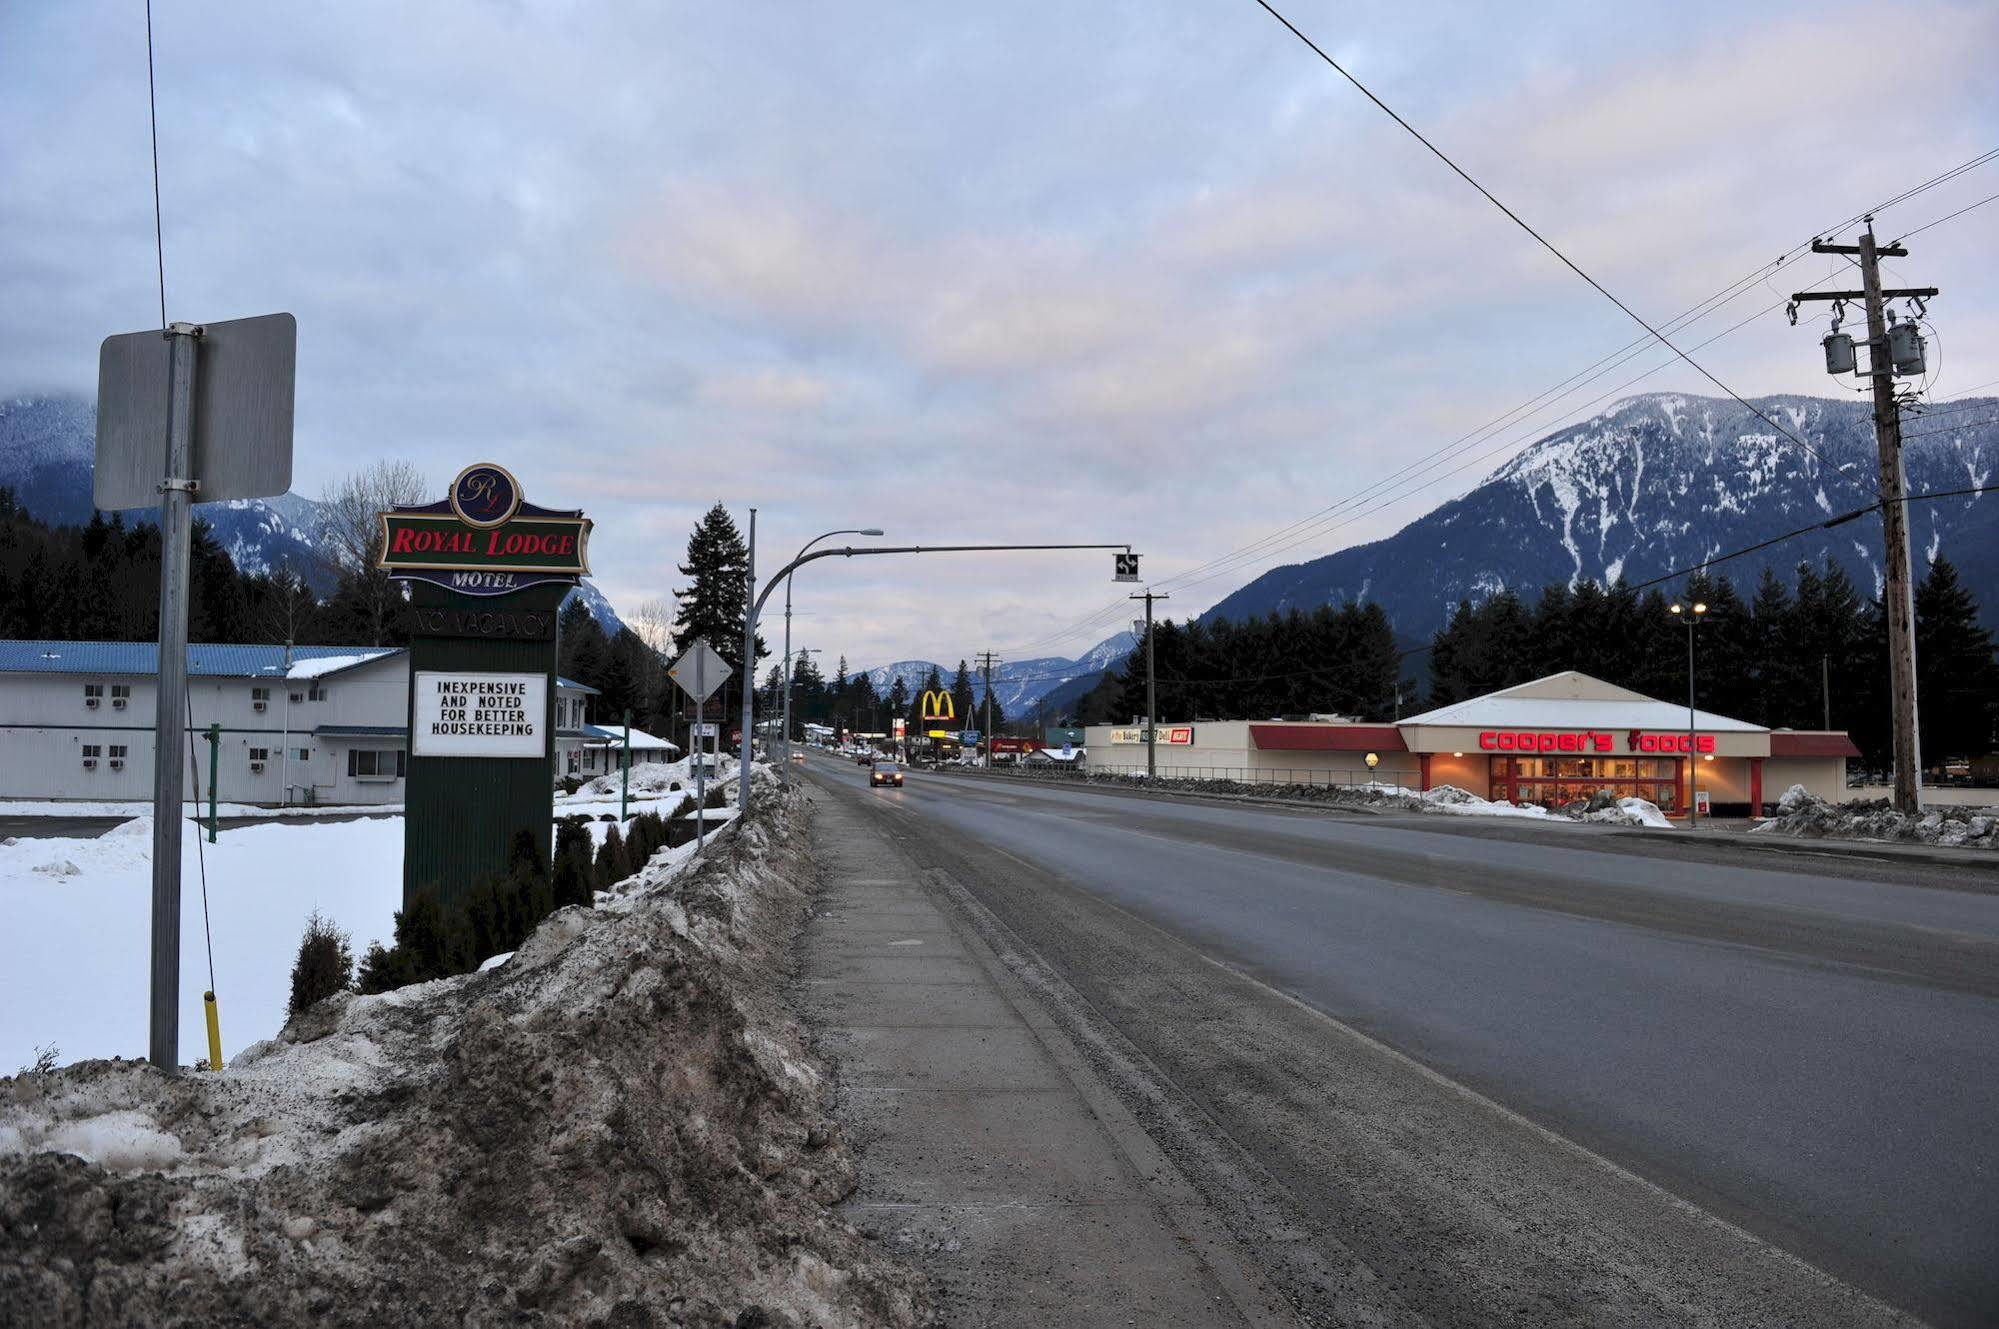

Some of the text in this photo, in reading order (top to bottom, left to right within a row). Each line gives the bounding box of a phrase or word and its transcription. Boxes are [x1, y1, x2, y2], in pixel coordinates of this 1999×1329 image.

[392, 527, 575, 556] ROYAL LODGE
[451, 572, 518, 588] MOTEL
[415, 608, 549, 636] NO VACANCY
[437, 682, 527, 695] INEXPENSIVE
[440, 695, 522, 708] AND NOTED
[441, 709, 525, 722] FOR BETTER
[432, 722, 533, 736] HOUSEKEEPING
[1480, 728, 1715, 752] cooper's foods
